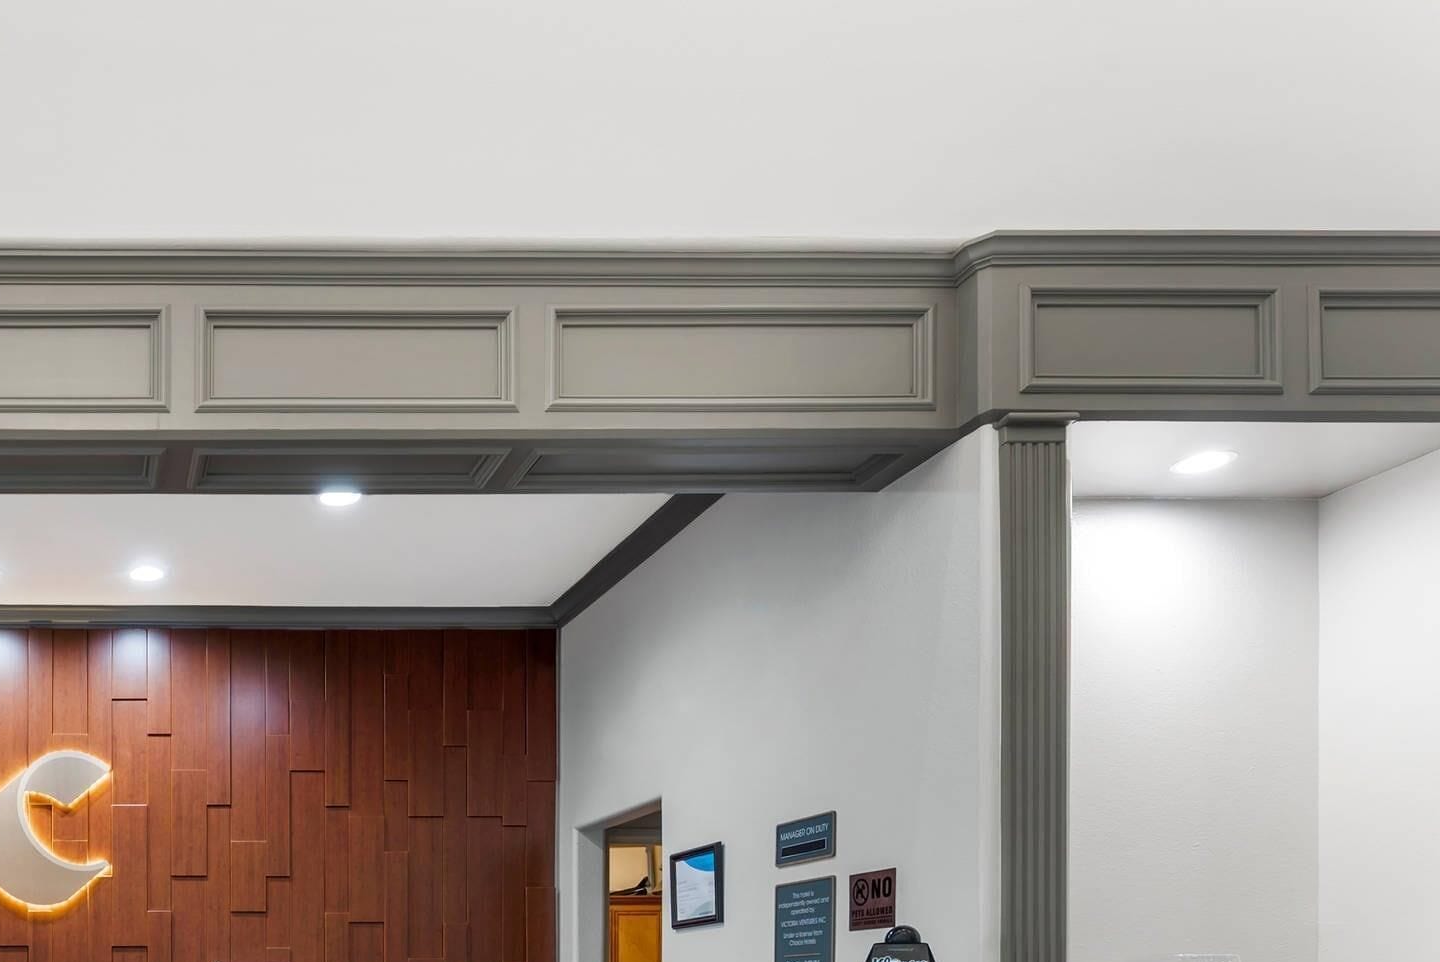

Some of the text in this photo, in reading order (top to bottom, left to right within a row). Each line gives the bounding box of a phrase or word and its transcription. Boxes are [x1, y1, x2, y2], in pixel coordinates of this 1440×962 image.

[780, 822, 830, 841] MANAGER ON DUTY
[871, 876, 892, 899] NO
[852, 905, 893, 918] PETS ALLOWED
